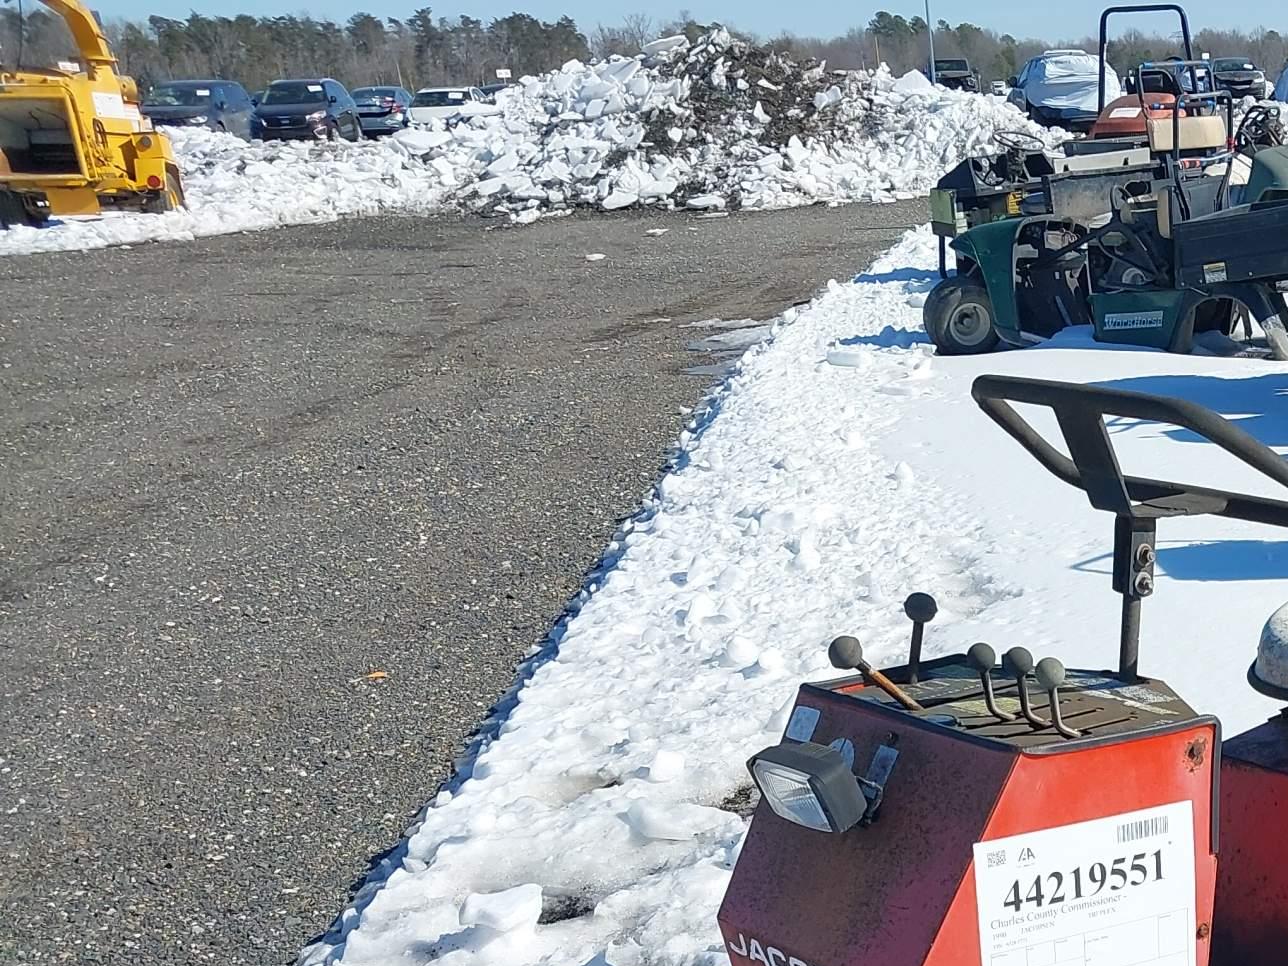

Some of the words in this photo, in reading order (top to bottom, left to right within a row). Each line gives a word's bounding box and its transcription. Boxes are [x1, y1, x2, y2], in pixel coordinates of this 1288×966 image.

[1003, 849, 1165, 912] 44219551
[990, 915, 1024, 930] Charles
[1026, 907, 1058, 921] County
[1061, 894, 1121, 914] Commissioner
